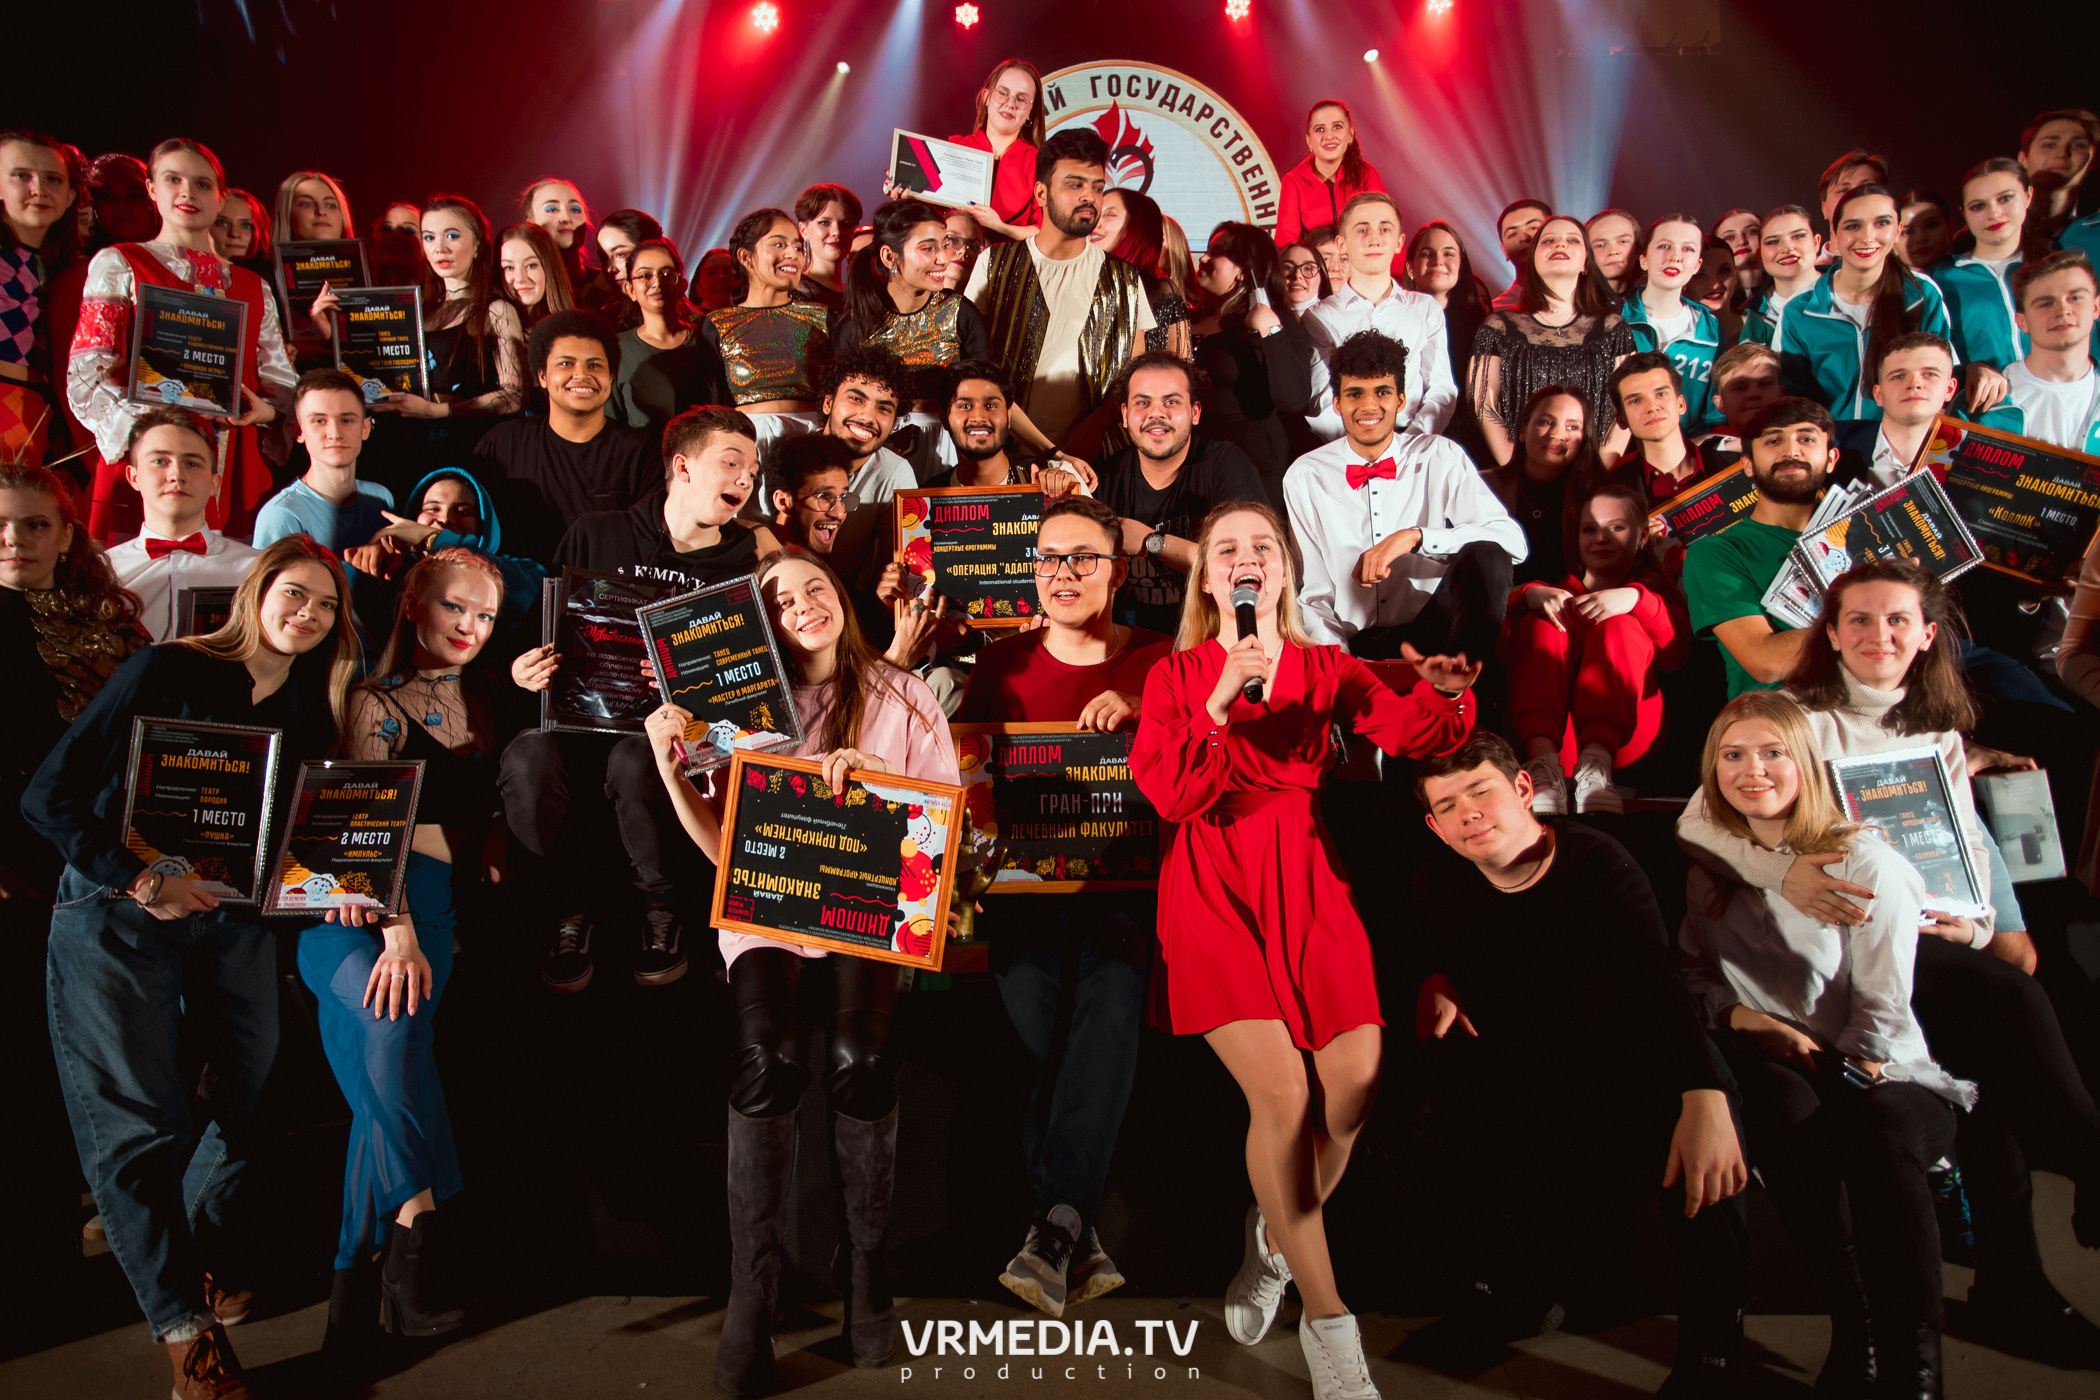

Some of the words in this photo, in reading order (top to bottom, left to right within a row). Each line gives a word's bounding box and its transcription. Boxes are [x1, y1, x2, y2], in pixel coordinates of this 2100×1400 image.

[295, 260, 351, 271] ЗНАКОМИТЬСЯ!
[159, 310, 226, 330] ЗНАКОМИТЬСЯ!
[178, 309, 209, 318] ДАВАЙ
[349, 310, 406, 321] ЗНАКОМИТЬСЯ!
[184, 350, 189, 359] 2
[192, 351, 225, 365] МЕСТО
[376, 346, 381, 356] 1
[382, 345, 410, 356] МЕСТО
[1674, 354, 1712, 384] 212
[1962, 441, 2025, 470] ДИПЛОМ
[2052, 475, 2081, 489] ДАВАЙ
[1873, 487, 1909, 514] ДИПЛОМ
[934, 504, 990, 524] ДИПЛОМ
[1672, 493, 1724, 530] ДИПЛОМ
[2040, 506, 2046, 518] 1
[2046, 509, 2078, 527] МЕСТО
[992, 521, 1041, 536] ЗНАКОМ
[1903, 499, 1946, 560] ЗНАКОМИТЬСЯ!
[1920, 512, 1944, 540] ДАВАЙ
[1026, 547, 1031, 558] 3
[1878, 543, 1886, 553] 3
[946, 564, 997, 576] «ОПЕРАЦИЯ
[598, 593, 648, 606] СЕРТИФИКАТ
[688, 612, 722, 629] ДАВАЙ
[671, 613, 745, 646] ЗНАКОМИТЬСЯ!
[656, 637, 678, 679] ДИПЛОМ
[678, 654, 712, 668] Направление:
[713, 648, 730, 658] ТАНЕЦ
[680, 663, 710, 676] Номинация:
[716, 650, 752, 667] СОВРЕМЕННЫЙ
[751, 645, 768, 656] ТАНЕЦ
[716, 673, 723, 687] 1
[724, 662, 762, 686] МЕСТО
[587, 682, 643, 694] студенческому
[708, 690, 736, 704] «МАСТЕР
[736, 688, 741, 697] И
[741, 678, 780, 695] МАРГАРИТА»
[187, 748, 228, 758] ДАВАЙ
[998, 745, 1062, 767] ДИПЛОМ
[1099, 757, 1128, 765] ДАВАЙ
[160, 754, 250, 774] ЗНАКОМИТЬСЯ!
[1876, 776, 1907, 787] ДАВАЙ
[201, 787, 220, 795] ТЕАТР
[320, 789, 398, 800] ЗНАКОМИТЬСЯ!
[1859, 781, 1928, 802] ЗНАКОМИТЬСЯ!
[200, 796, 228, 805] ПАРОДИЯ
[1040, 792, 1122, 815] ГРАН-ПРИ
[193, 809, 198, 823] 1
[202, 810, 246, 827] МЕСТО
[780, 812, 812, 824] факультет
[813, 818, 846, 829] Лечебный
[200, 831, 234, 841] «ПУШКА»
[754, 822, 836, 848] ПРИКРЫТИЕМ»
[1011, 820, 1076, 840] ЛЕЧЕБНЫЙ
[1080, 820, 1154, 838] ФАКУЛЬТЕТ
[341, 832, 349, 844] 2
[351, 832, 391, 845] МЕСТО
[839, 834, 868, 853] «ПОД
[1901, 834, 1908, 848] 1
[1909, 829, 1944, 846] МЕСТО
[344, 850, 382, 858] «ИМПУЛЬС»
[744, 840, 778, 858] МЕСТО
[778, 846, 786, 859] 2
[818, 864, 857, 879] ПРОГРАММЫ
[858, 871, 898, 886] КОНЦЕРТНЫЕ
[753, 890, 784, 902] ДАВАЙ
[820, 904, 891, 937] ДИПЛОМ
